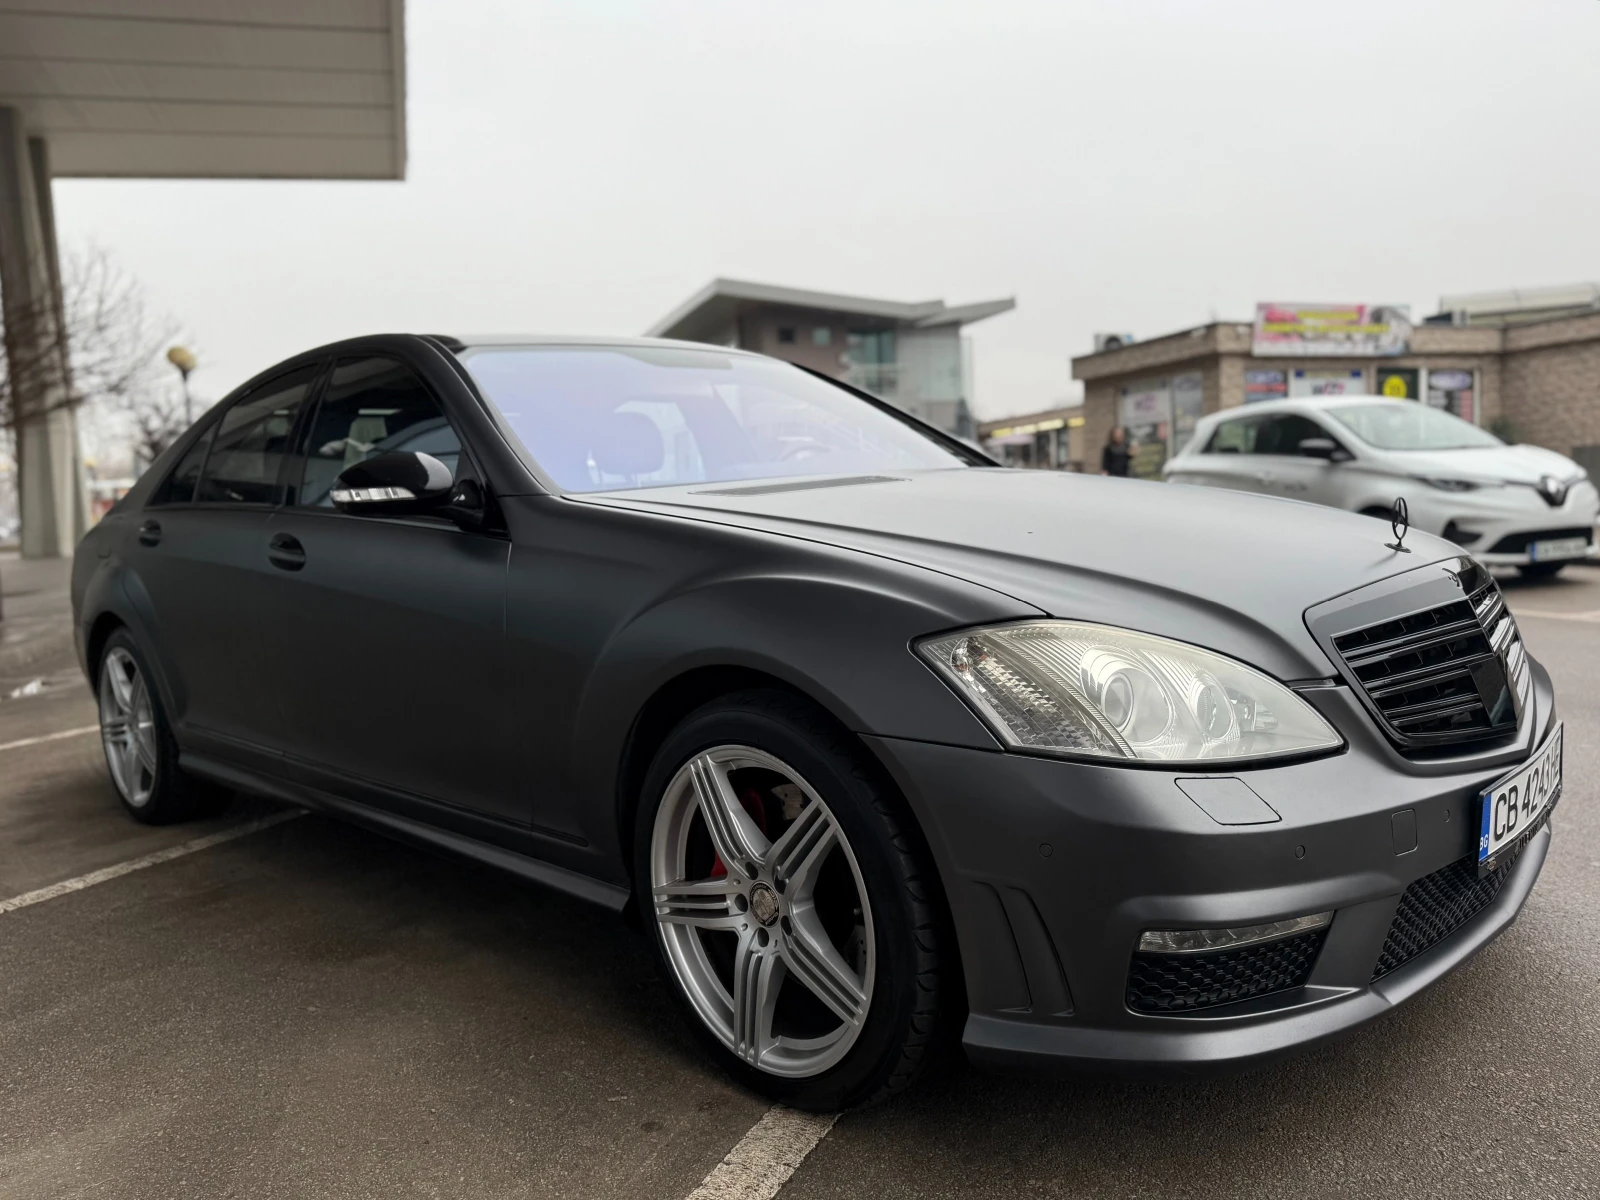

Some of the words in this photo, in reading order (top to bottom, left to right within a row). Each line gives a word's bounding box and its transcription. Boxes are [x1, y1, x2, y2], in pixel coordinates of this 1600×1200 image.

[1494, 784, 1518, 842] CB
[1521, 752, 1550, 818] 4243
[1480, 833, 1489, 851] BG
